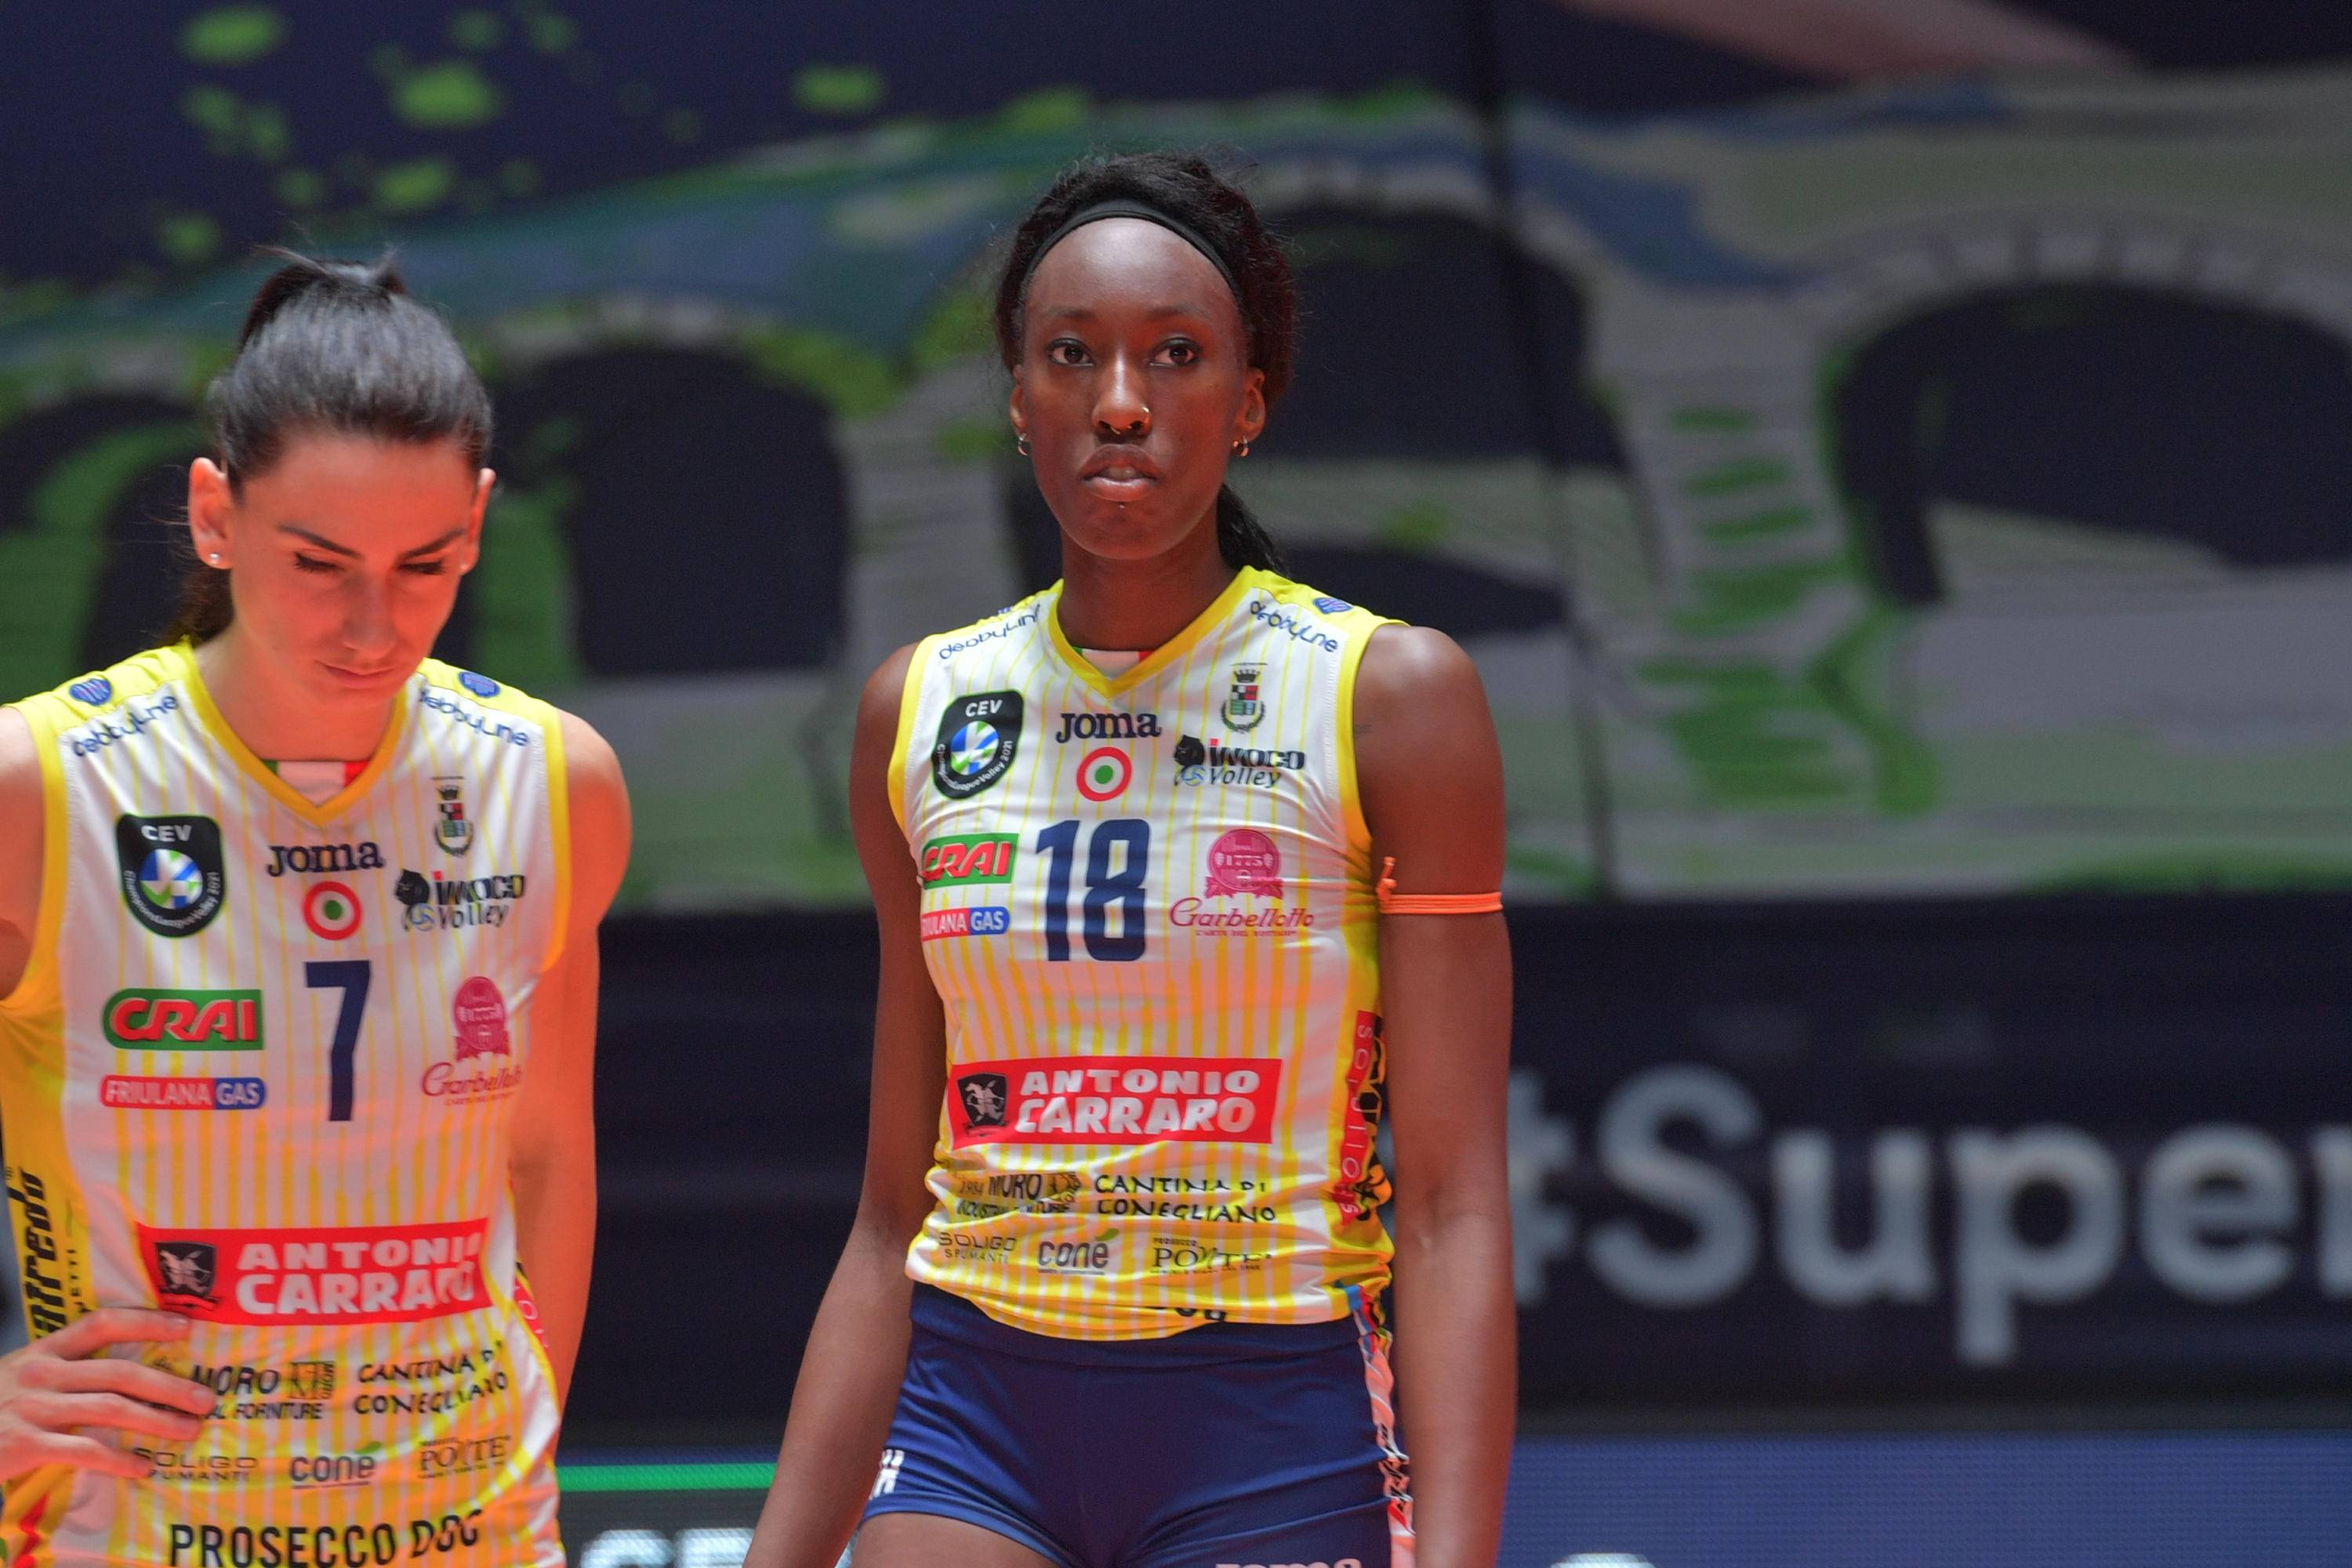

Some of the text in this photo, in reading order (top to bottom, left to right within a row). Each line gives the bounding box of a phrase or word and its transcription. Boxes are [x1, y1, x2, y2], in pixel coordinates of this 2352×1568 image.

[965, 699, 1003, 717] CEV
[1210, 767, 1282, 789] Volley
[141, 824, 192, 843] CEV
[921, 840, 1011, 881] CRAI
[1035, 818, 1150, 962] 18
[971, 910, 1004, 931] GAS
[1170, 897, 1314, 927] Garbellotto
[108, 997, 257, 1042] CRAI
[304, 960, 371, 1122] 7
[104, 1079, 260, 1107] FRIULANA GAS
[1020, 1069, 1261, 1096] ANTONIO
[1014, 1096, 1256, 1134] CARRARO
[1094, 1174, 1265, 1193] CANTINA DI
[1097, 1198, 1276, 1223] CONEGLIANO
[939, 1232, 1017, 1252] SOLIGO
[358, 1352, 476, 1383] CANTINA
[354, 1371, 508, 1414] CONEGLIANO
[169, 1521, 397, 1568] PROSECCO
